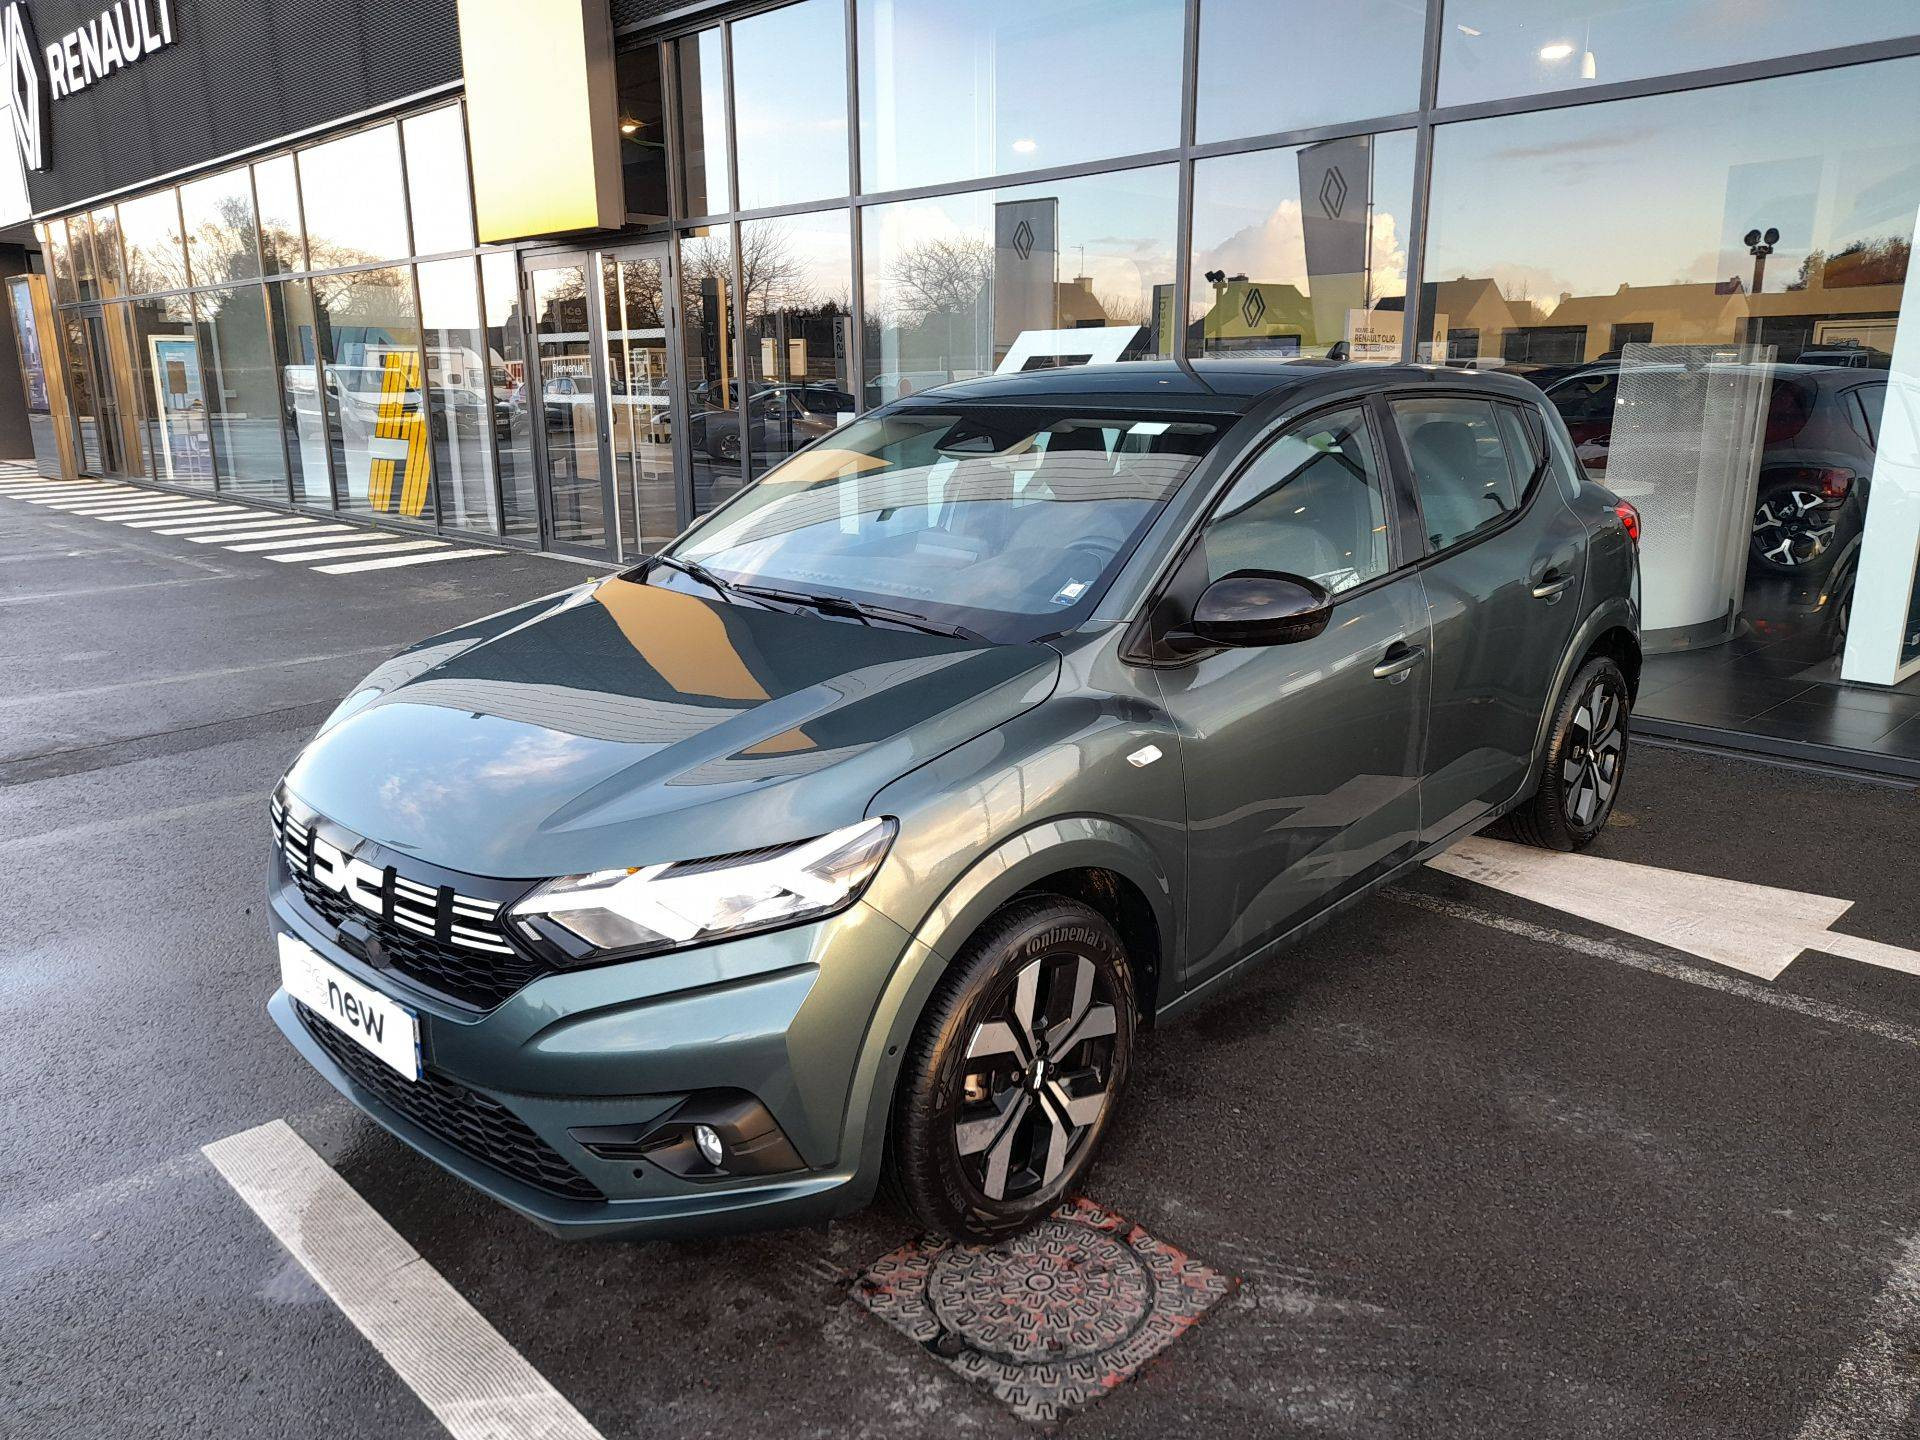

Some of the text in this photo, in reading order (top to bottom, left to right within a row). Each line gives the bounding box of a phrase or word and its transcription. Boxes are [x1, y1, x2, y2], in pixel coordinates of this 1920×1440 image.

[46, 0, 171, 100] RENAULT
[553, 363, 584, 373] Bienvenue
[1025, 926, 1100, 955] Continental
[328, 979, 384, 1044] new
